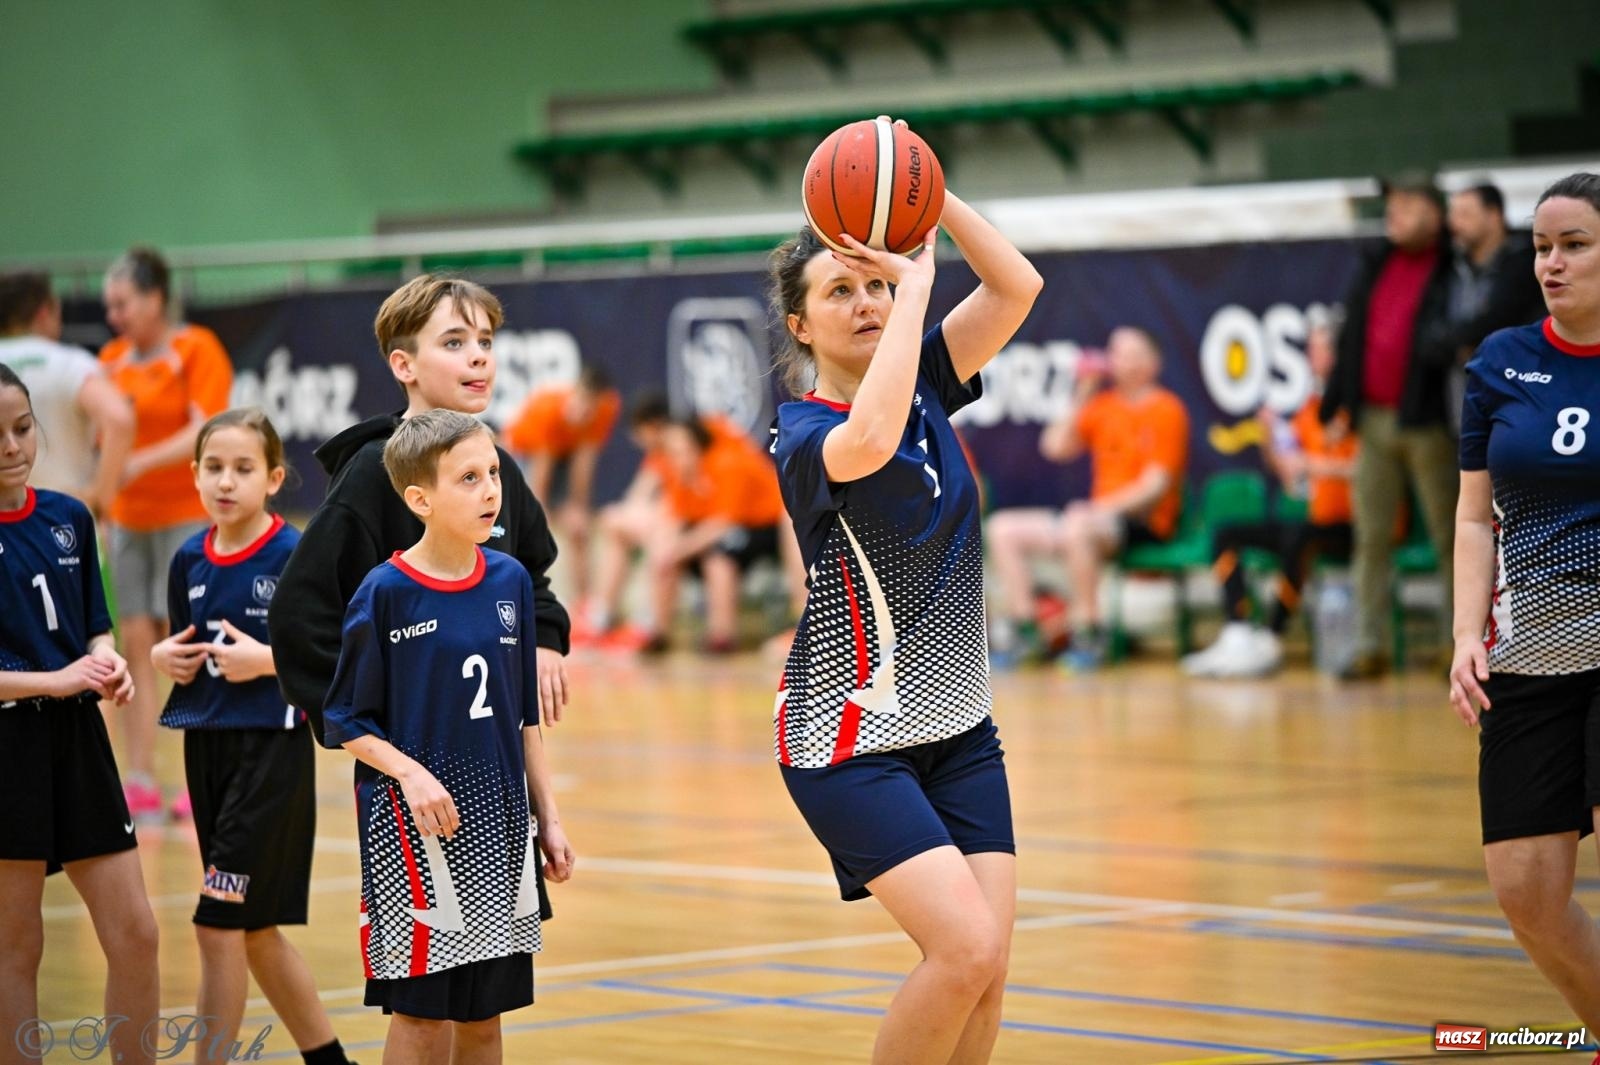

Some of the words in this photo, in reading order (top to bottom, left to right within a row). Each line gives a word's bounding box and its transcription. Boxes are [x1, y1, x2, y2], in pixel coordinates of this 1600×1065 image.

[906, 145, 922, 207] molten
[1551, 406, 1590, 456] 8
[32, 573, 59, 632] 1
[462, 654, 494, 720] 2
